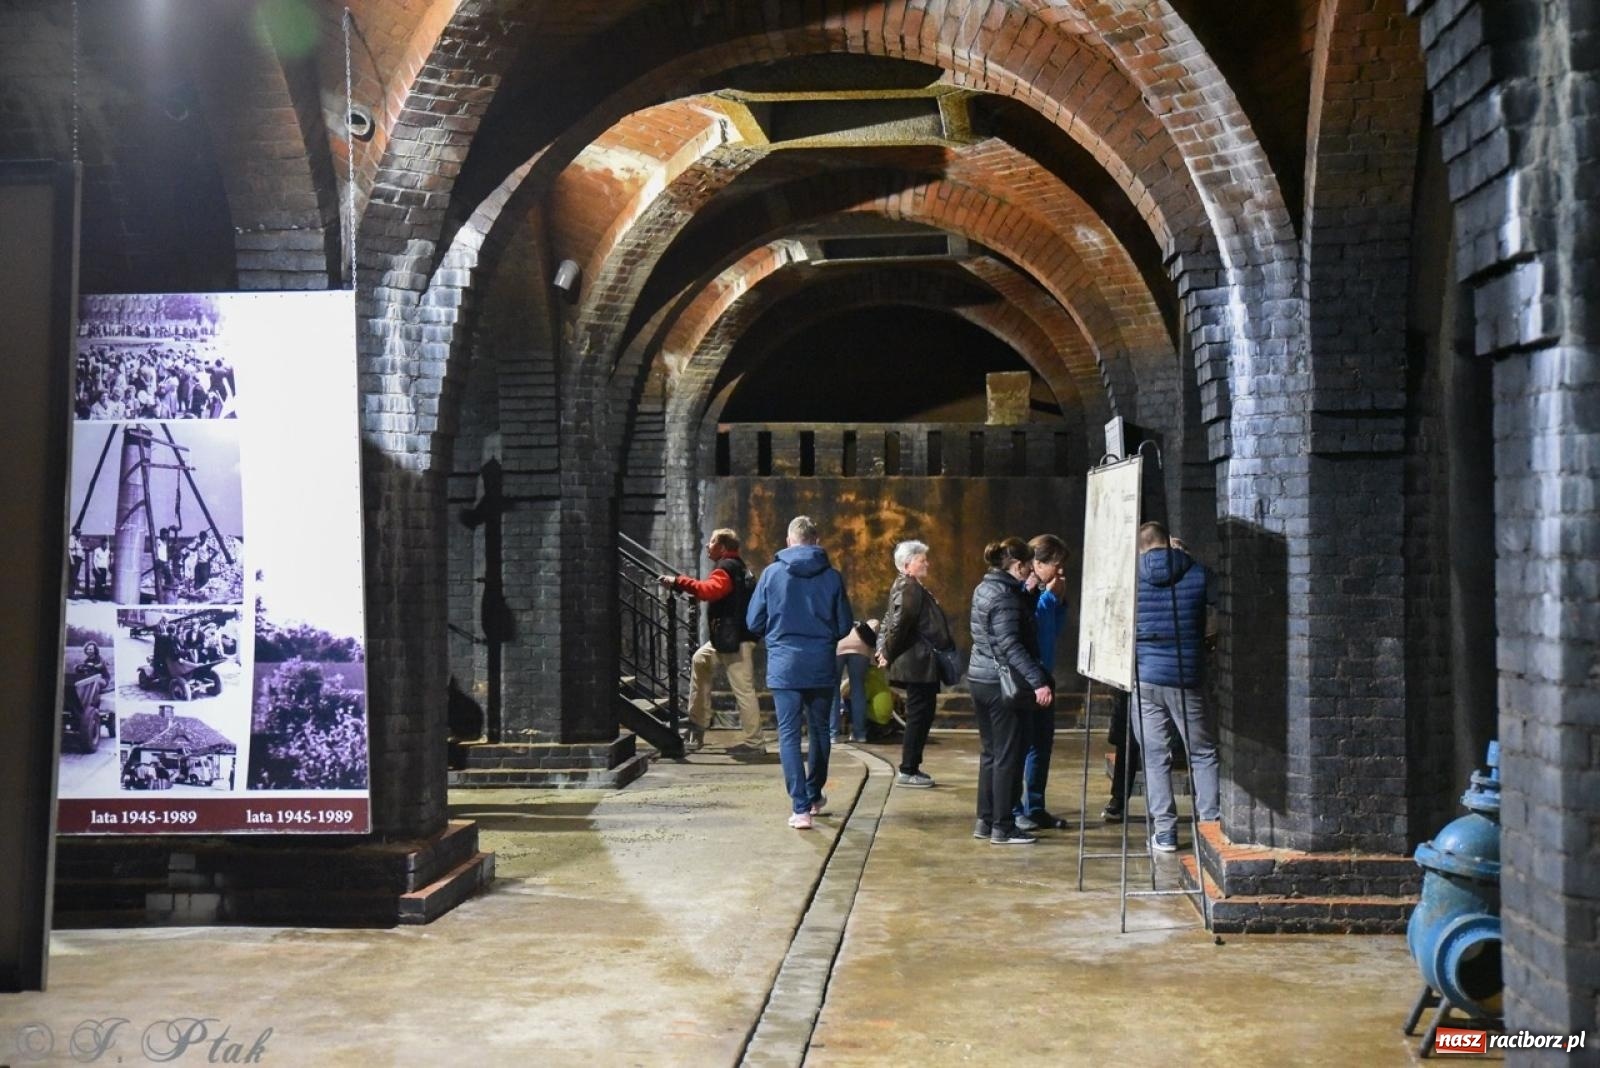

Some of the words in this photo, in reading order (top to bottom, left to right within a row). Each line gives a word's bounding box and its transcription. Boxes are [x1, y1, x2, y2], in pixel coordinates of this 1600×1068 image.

[91, 810, 118, 824] lata
[121, 810, 197, 824] 1945-1989
[246, 809, 273, 823] lata
[277, 809, 353, 823] 1945-1989
